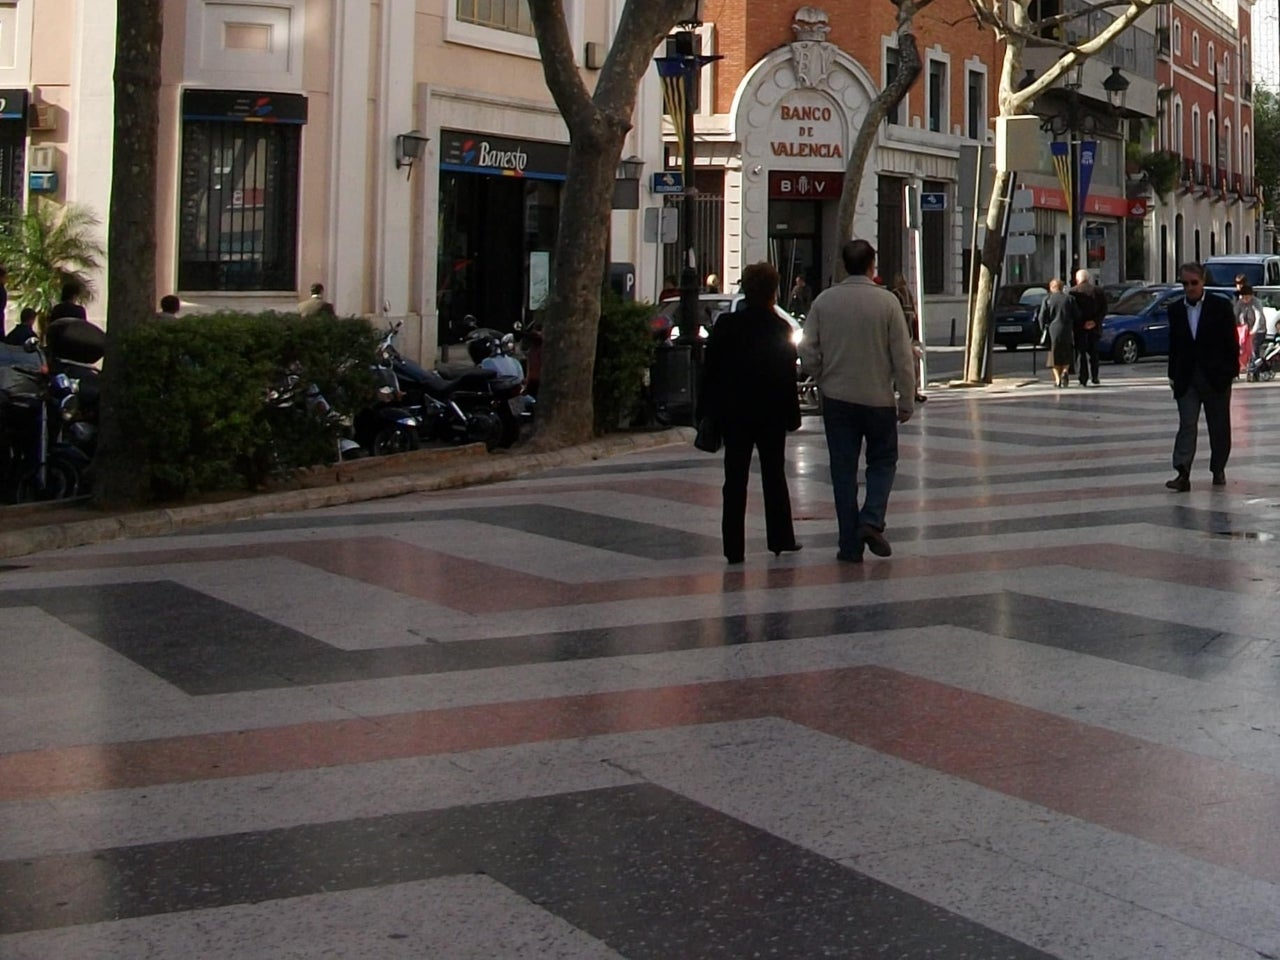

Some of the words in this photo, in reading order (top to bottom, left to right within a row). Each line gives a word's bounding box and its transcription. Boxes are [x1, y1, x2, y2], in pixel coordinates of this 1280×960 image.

[780, 105, 832, 122] BANCO
[799, 126, 814, 137] DE
[478, 141, 528, 175] Banesto
[770, 141, 843, 158] VALENCIA
[780, 180, 792, 192] B
[815, 181, 826, 192] V
[626, 273, 634, 292] P
